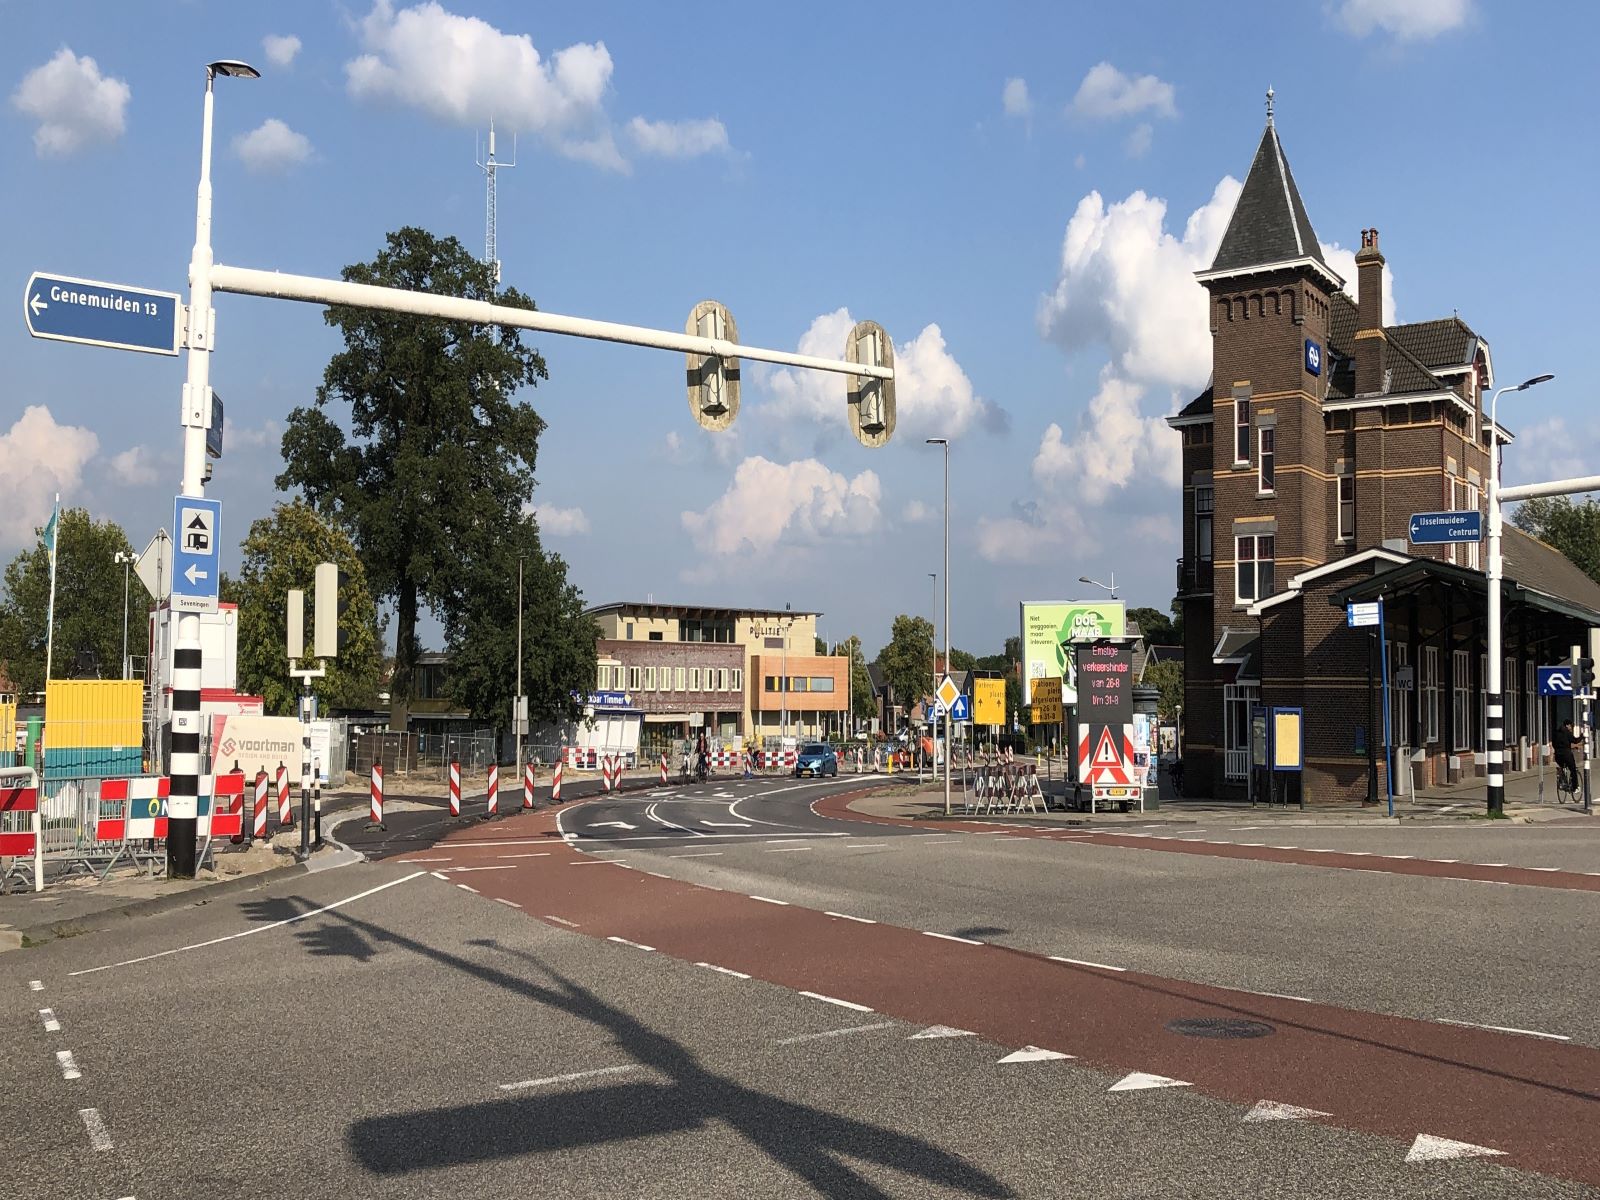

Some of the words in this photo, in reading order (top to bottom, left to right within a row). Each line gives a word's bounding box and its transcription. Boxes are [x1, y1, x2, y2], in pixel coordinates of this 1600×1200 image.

[50, 286, 140, 314] Genemuiden
[144, 302, 158, 316] 13
[1448, 528, 1479, 537] Centrum
[1074, 613, 1097, 628] DOE
[749, 623, 781, 638] POLITIE
[1082, 661, 1129, 672] verkeershinder
[1091, 679, 1105, 688] van
[1105, 677, 1121, 688] 26-8
[1397, 679, 1412, 689] WC
[603, 694, 625, 705] Timmer
[1104, 694, 1119, 705] 31-8
[238, 738, 295, 753] voortman
